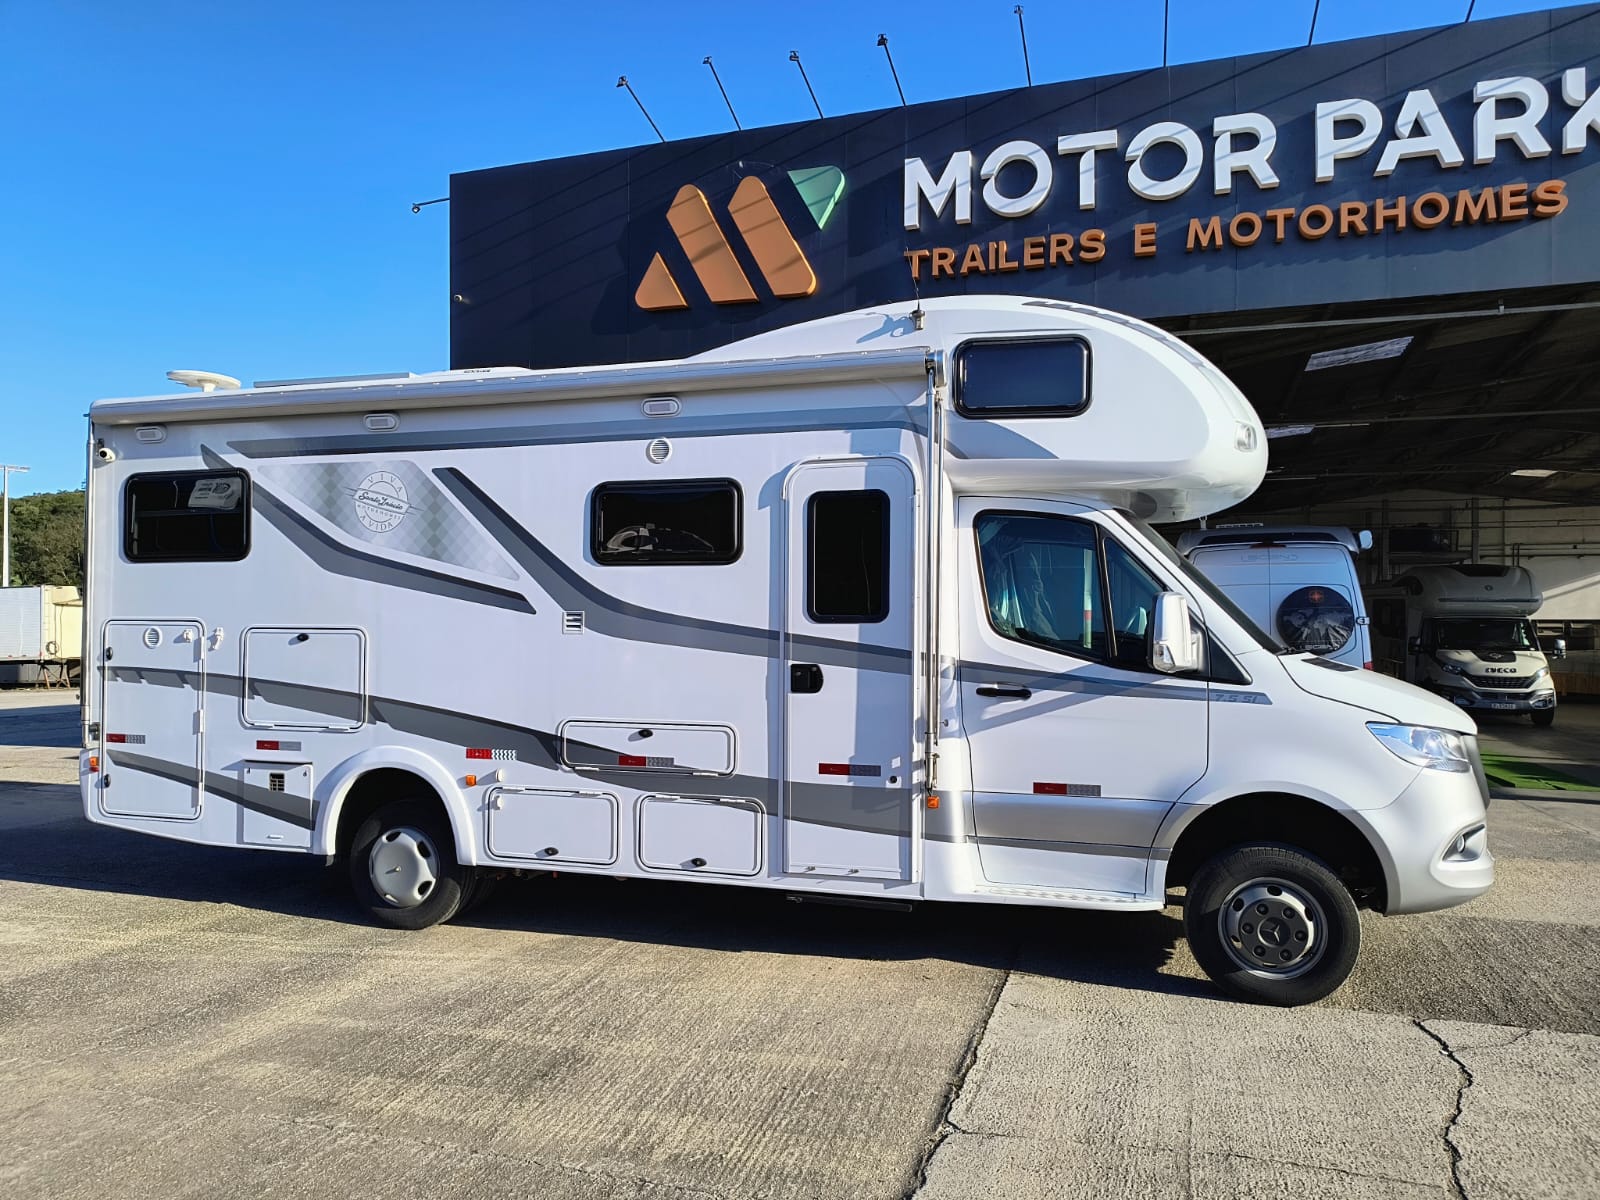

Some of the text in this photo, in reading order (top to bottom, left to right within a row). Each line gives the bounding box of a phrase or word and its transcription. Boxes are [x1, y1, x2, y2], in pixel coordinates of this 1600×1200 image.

[904, 112, 1280, 230] MOTOR
[904, 180, 1568, 280] TRAILERS E MOTORHOMES
[367, 473, 403, 492] VIVA
[368, 520, 393, 531] VIDA
